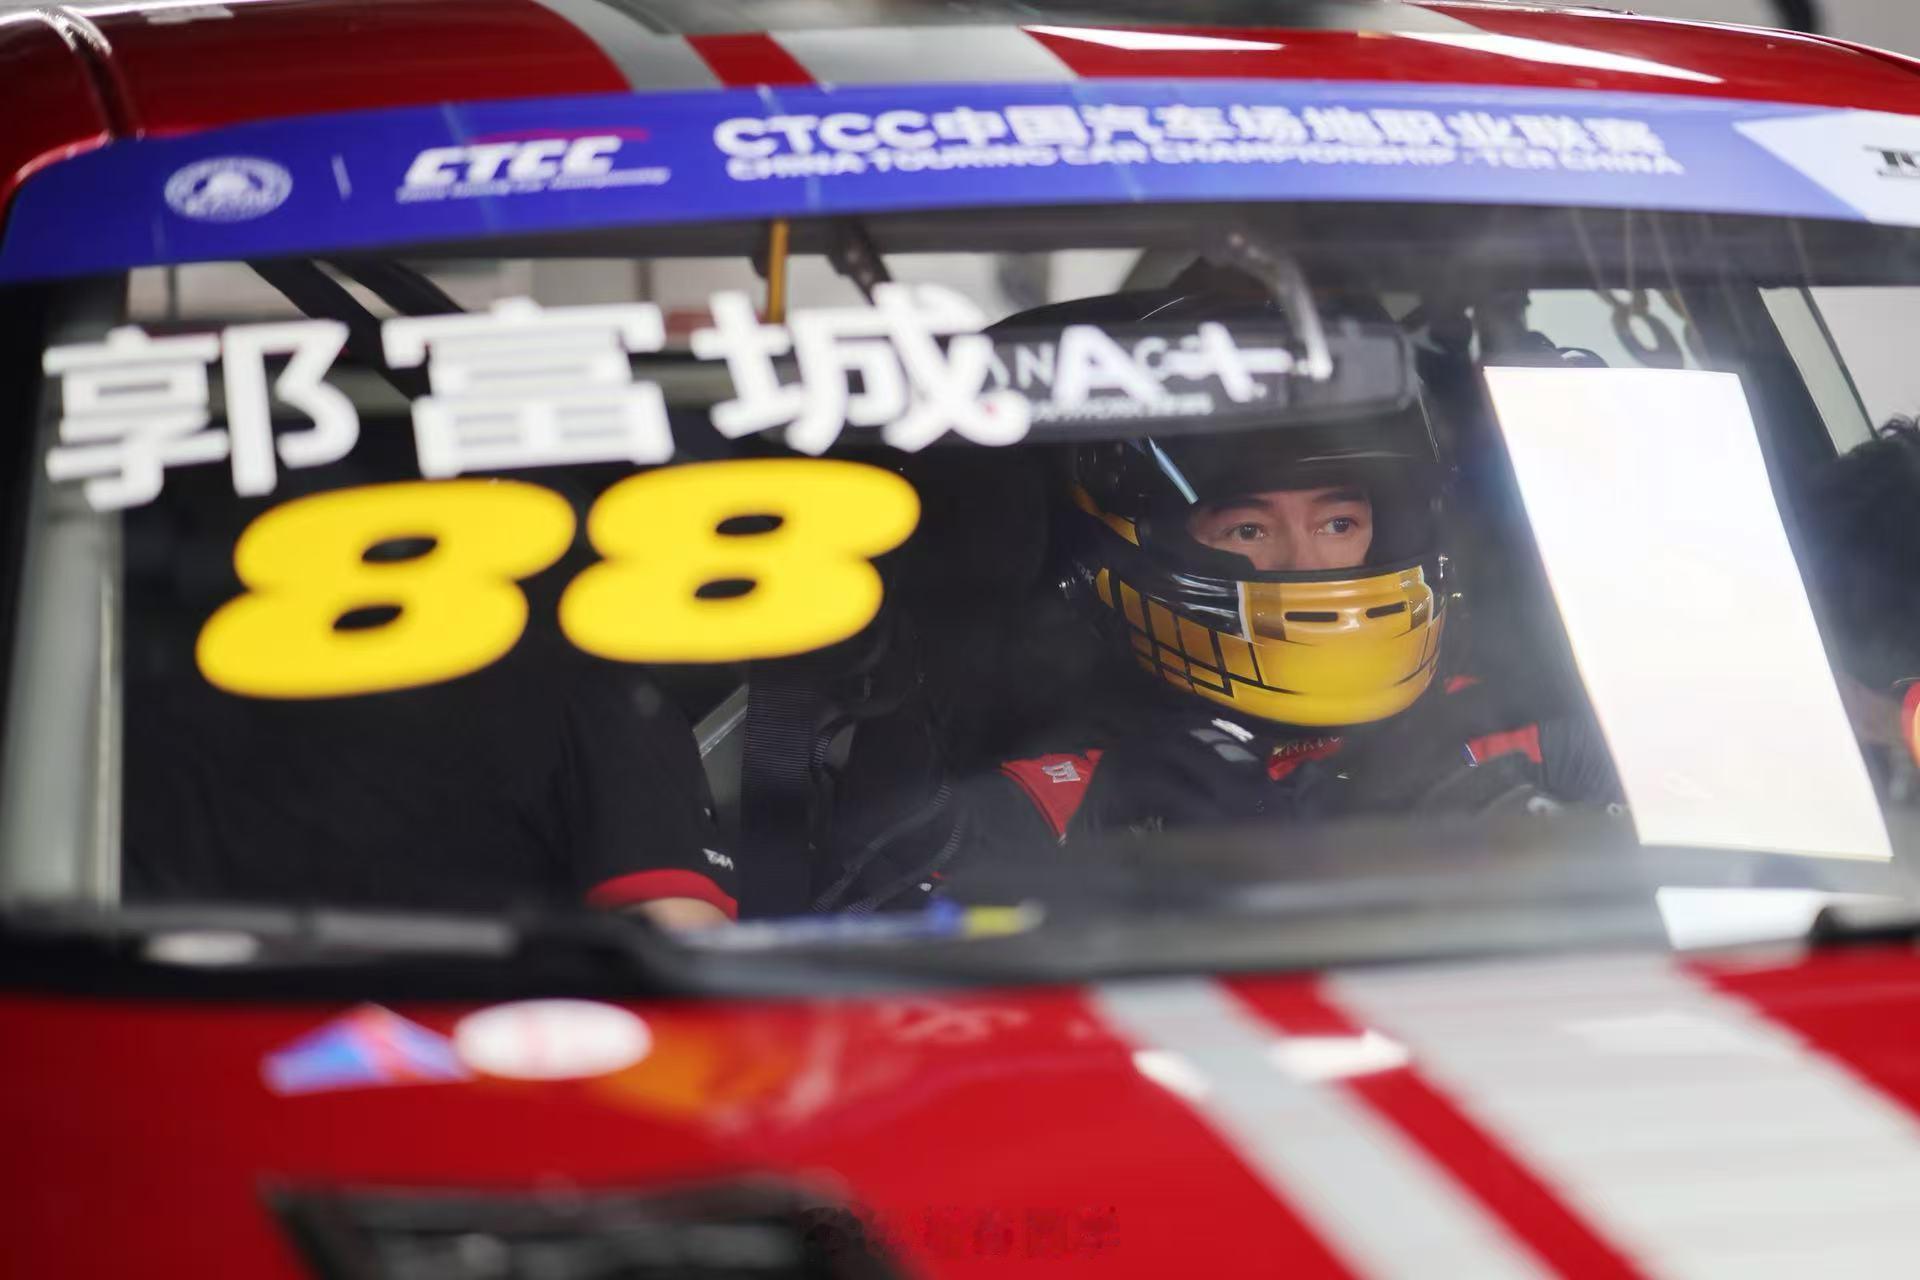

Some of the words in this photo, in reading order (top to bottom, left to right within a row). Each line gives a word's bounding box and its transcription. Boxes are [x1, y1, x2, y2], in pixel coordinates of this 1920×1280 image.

[404, 135, 623, 189] CTCC
[42, 283, 1031, 512] 郭富城
[195, 459, 921, 699] 88
